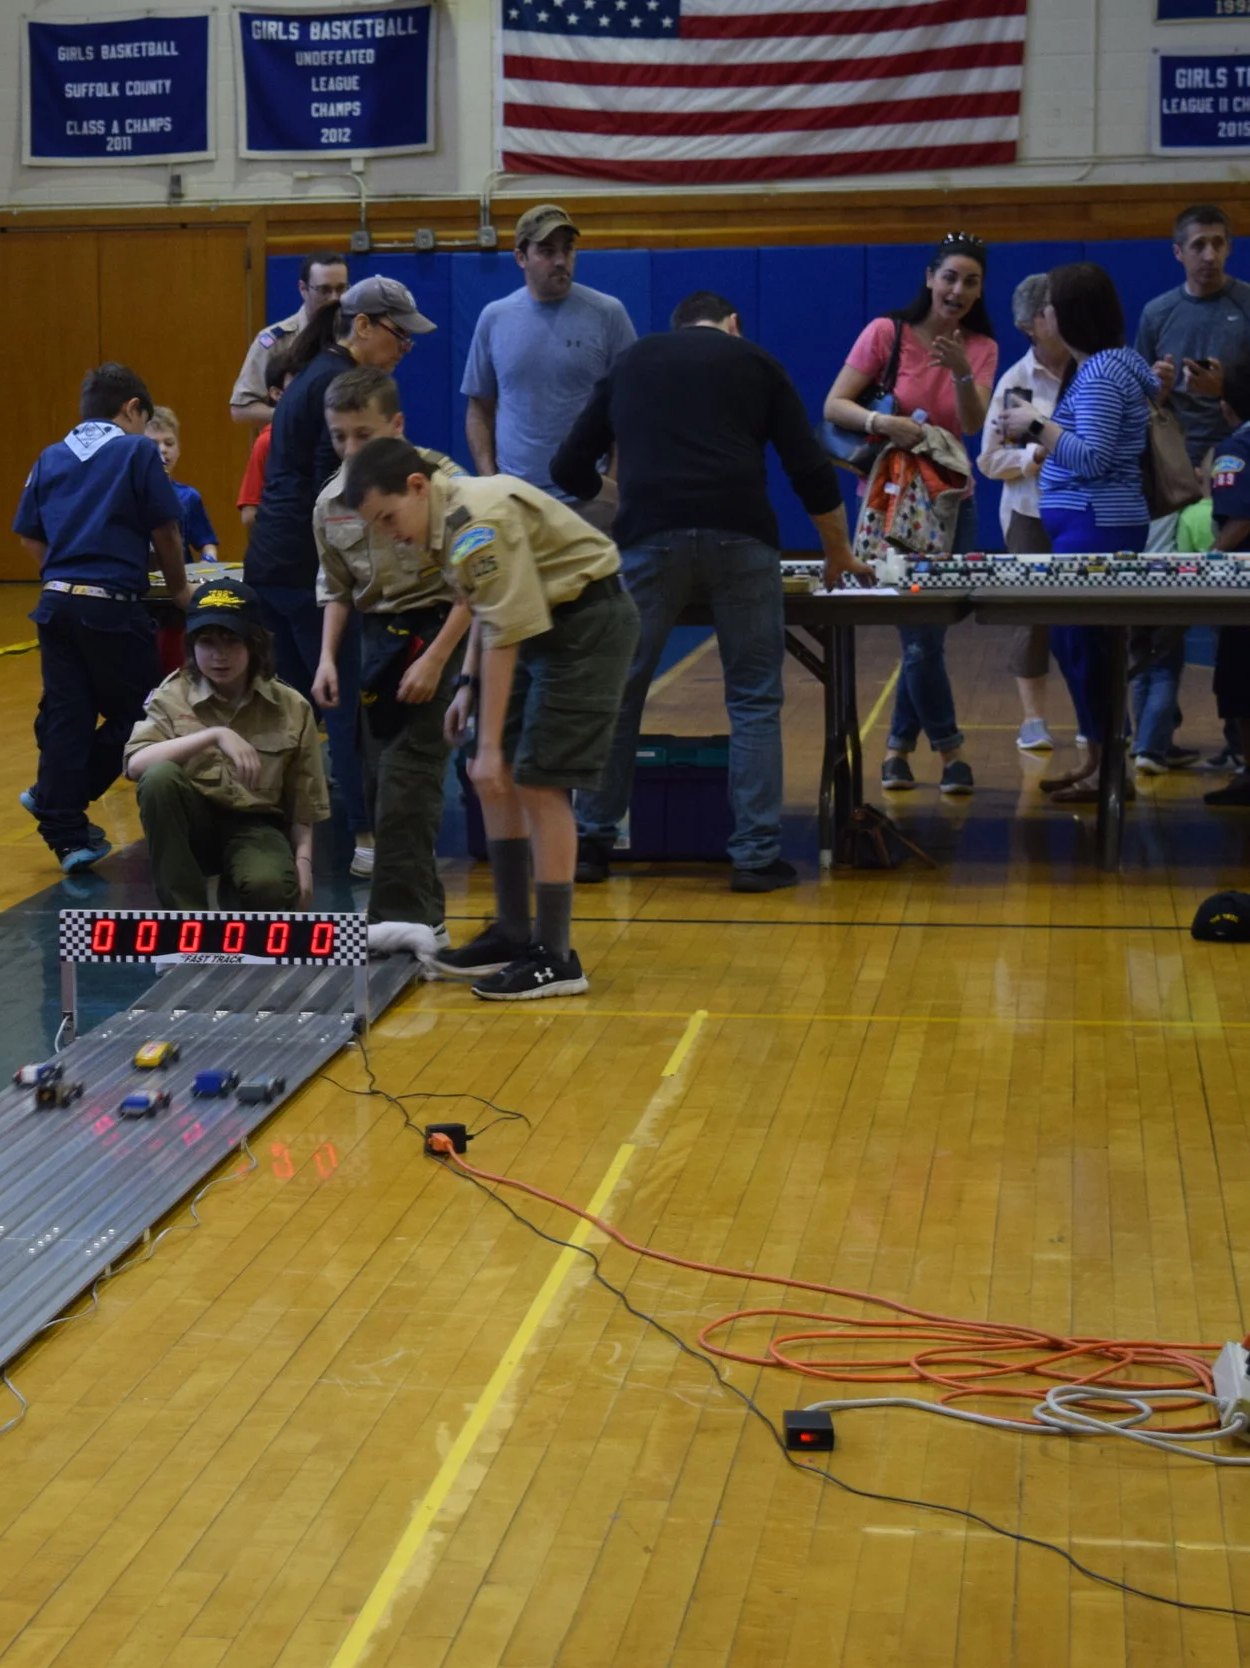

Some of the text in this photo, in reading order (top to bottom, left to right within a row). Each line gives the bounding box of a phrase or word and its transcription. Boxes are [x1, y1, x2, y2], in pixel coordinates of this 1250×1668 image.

[1216, 0, 1250, 14] 199
[252, 16, 418, 41] GIRLS BASKETBALL
[58, 41, 178, 61] GIRLS BASKETBALL
[296, 49, 374, 67] UNDEFEATED
[65, 80, 172, 98] SUFFOLK COUNTY
[311, 76, 360, 92] LEAGUE
[311, 102, 360, 117] CHAMPS
[1162, 98, 1214, 114] LEAGUE
[66, 117, 172, 135] CLASS A CHAMPS
[321, 127, 351, 143] 2012
[106, 136, 131, 151] 2011
[92, 920, 334, 954] 0 0 0 0 0 0
[184, 955, 245, 963] FAST TRACK
